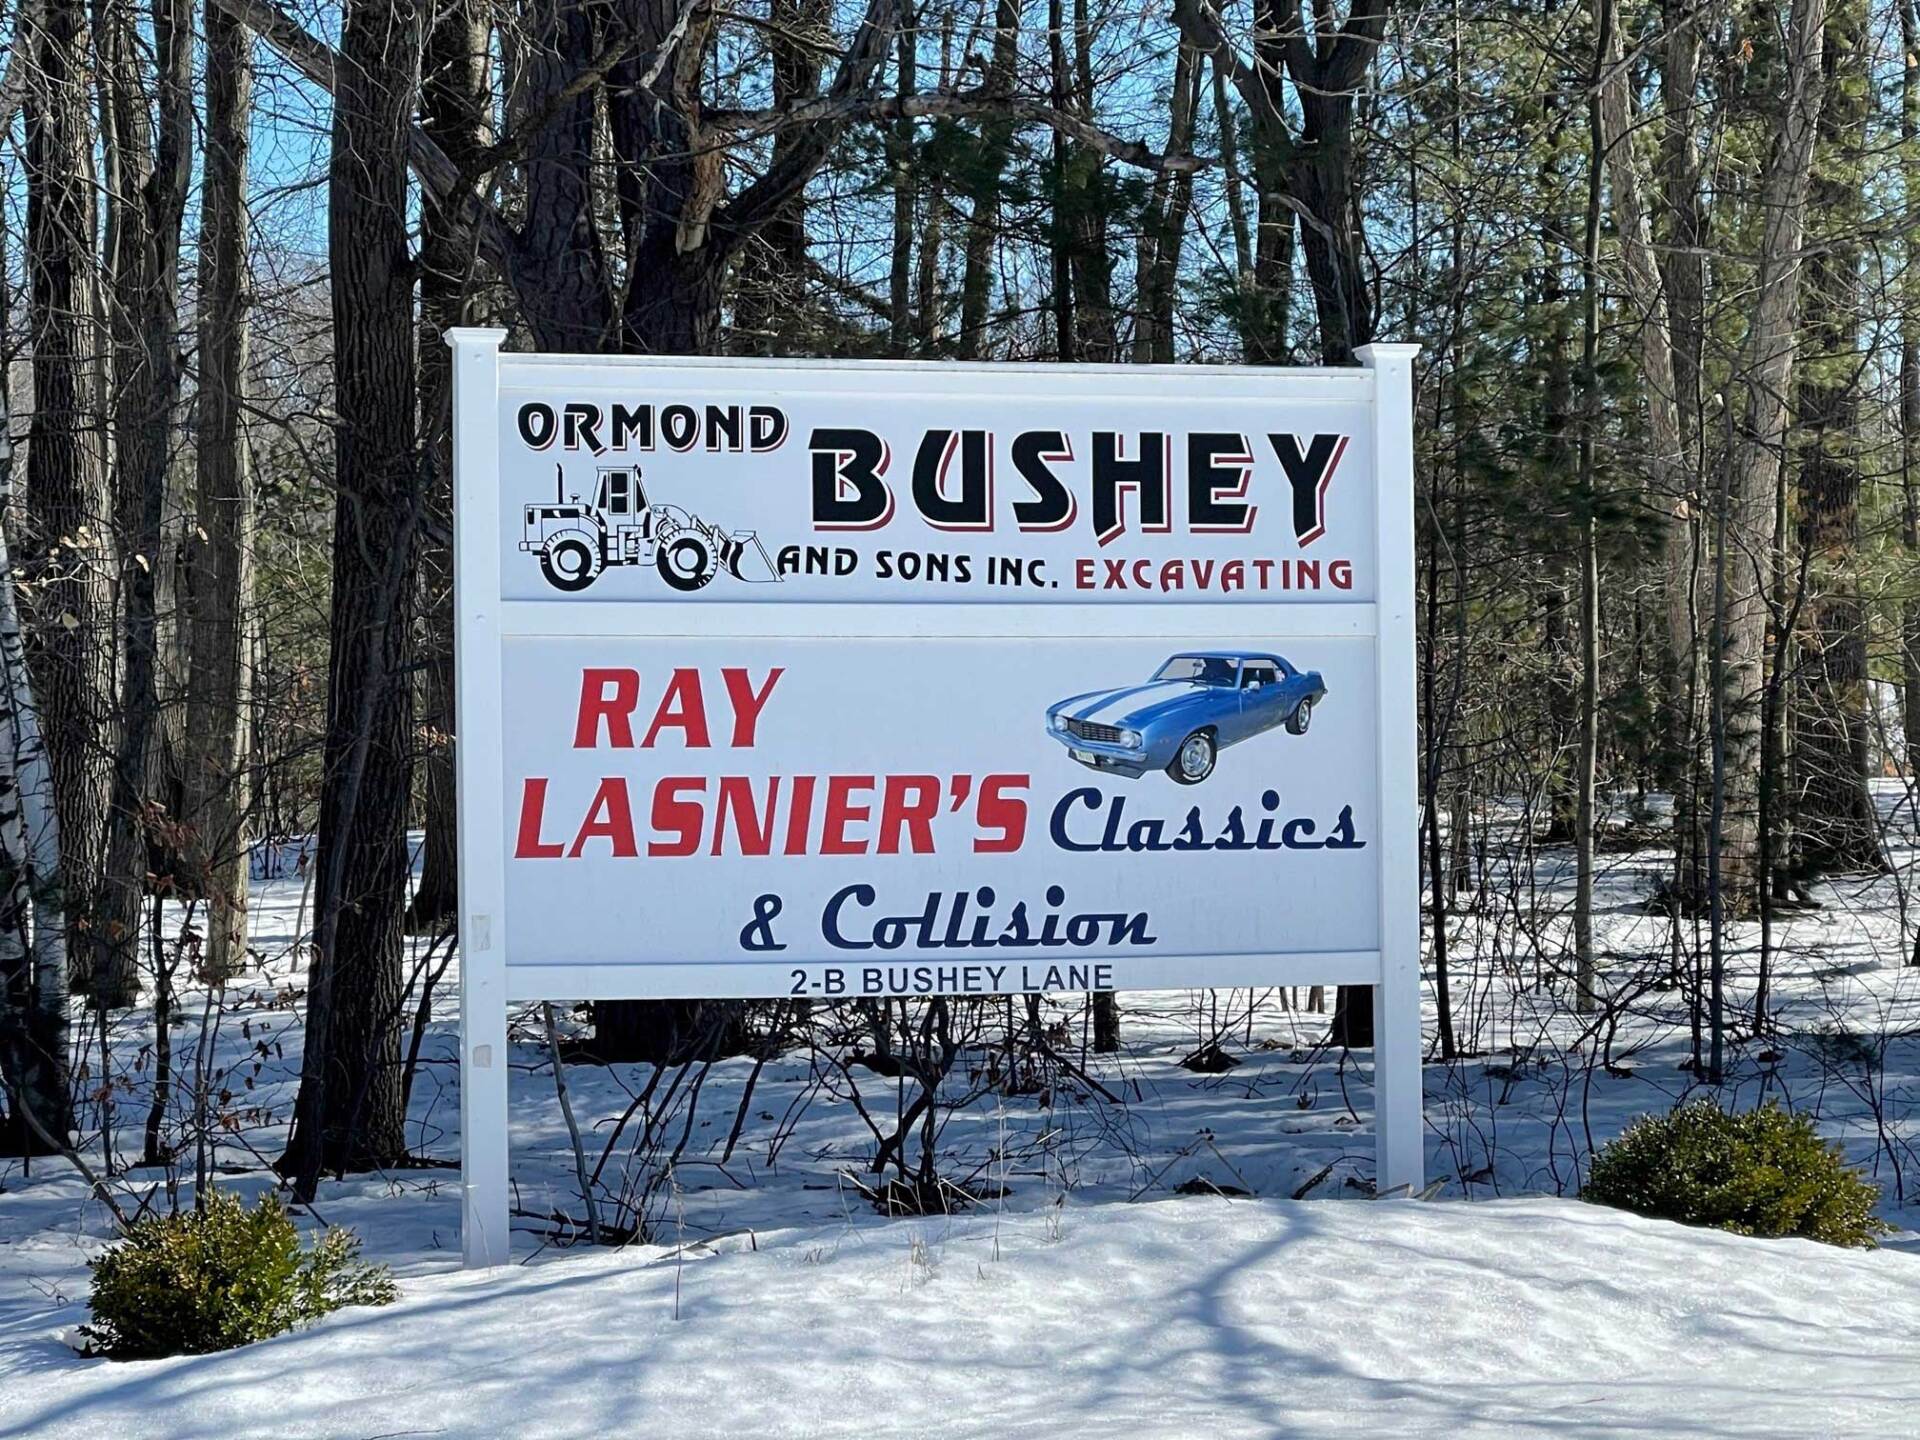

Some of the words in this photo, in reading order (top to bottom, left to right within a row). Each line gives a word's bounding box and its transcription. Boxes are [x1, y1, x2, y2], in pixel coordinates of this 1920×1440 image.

[517, 402, 789, 457] ORMOND
[808, 428, 1349, 549] BUSHEY
[777, 545, 858, 577] AND
[875, 551, 972, 583] SONS
[987, 557, 1058, 588] INC.
[1075, 559, 1353, 593] EXCAVATING
[573, 667, 786, 749] RAY
[514, 774, 1030, 858] LASNIER'S
[1049, 787, 1367, 852] Classics
[740, 893, 787, 951] &
[821, 883, 1157, 949] Collision
[790, 970, 846, 995] 2-B
[862, 966, 1006, 993] BUSHEY
[1022, 964, 1113, 990] LANE
